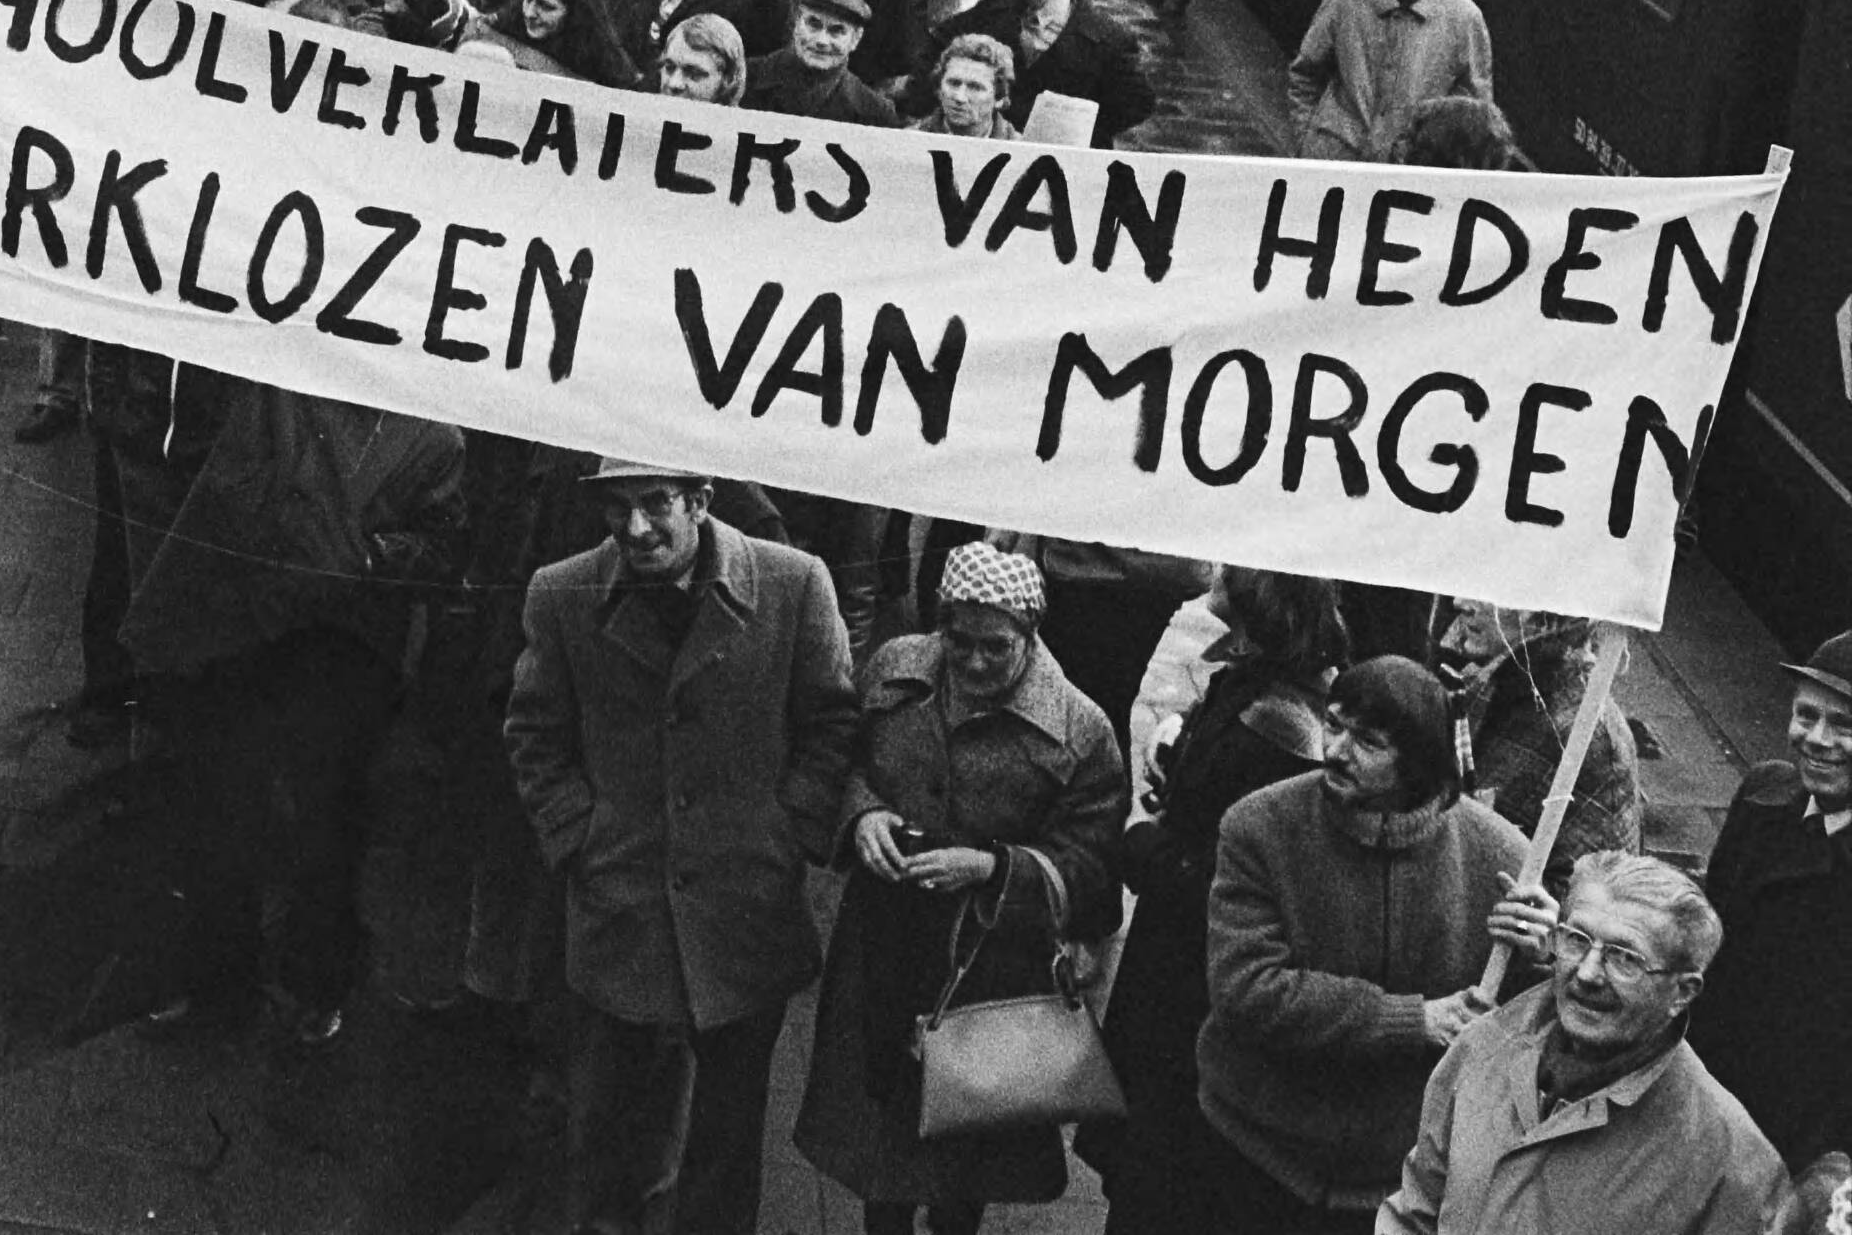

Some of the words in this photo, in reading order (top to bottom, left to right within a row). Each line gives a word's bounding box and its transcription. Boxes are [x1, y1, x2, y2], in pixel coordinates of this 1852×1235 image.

[929, 149, 1186, 284] VAN
[1252, 175, 1761, 346] HEDEN
[674, 267, 968, 446] VAN
[1034, 330, 1715, 540] MORGEN
